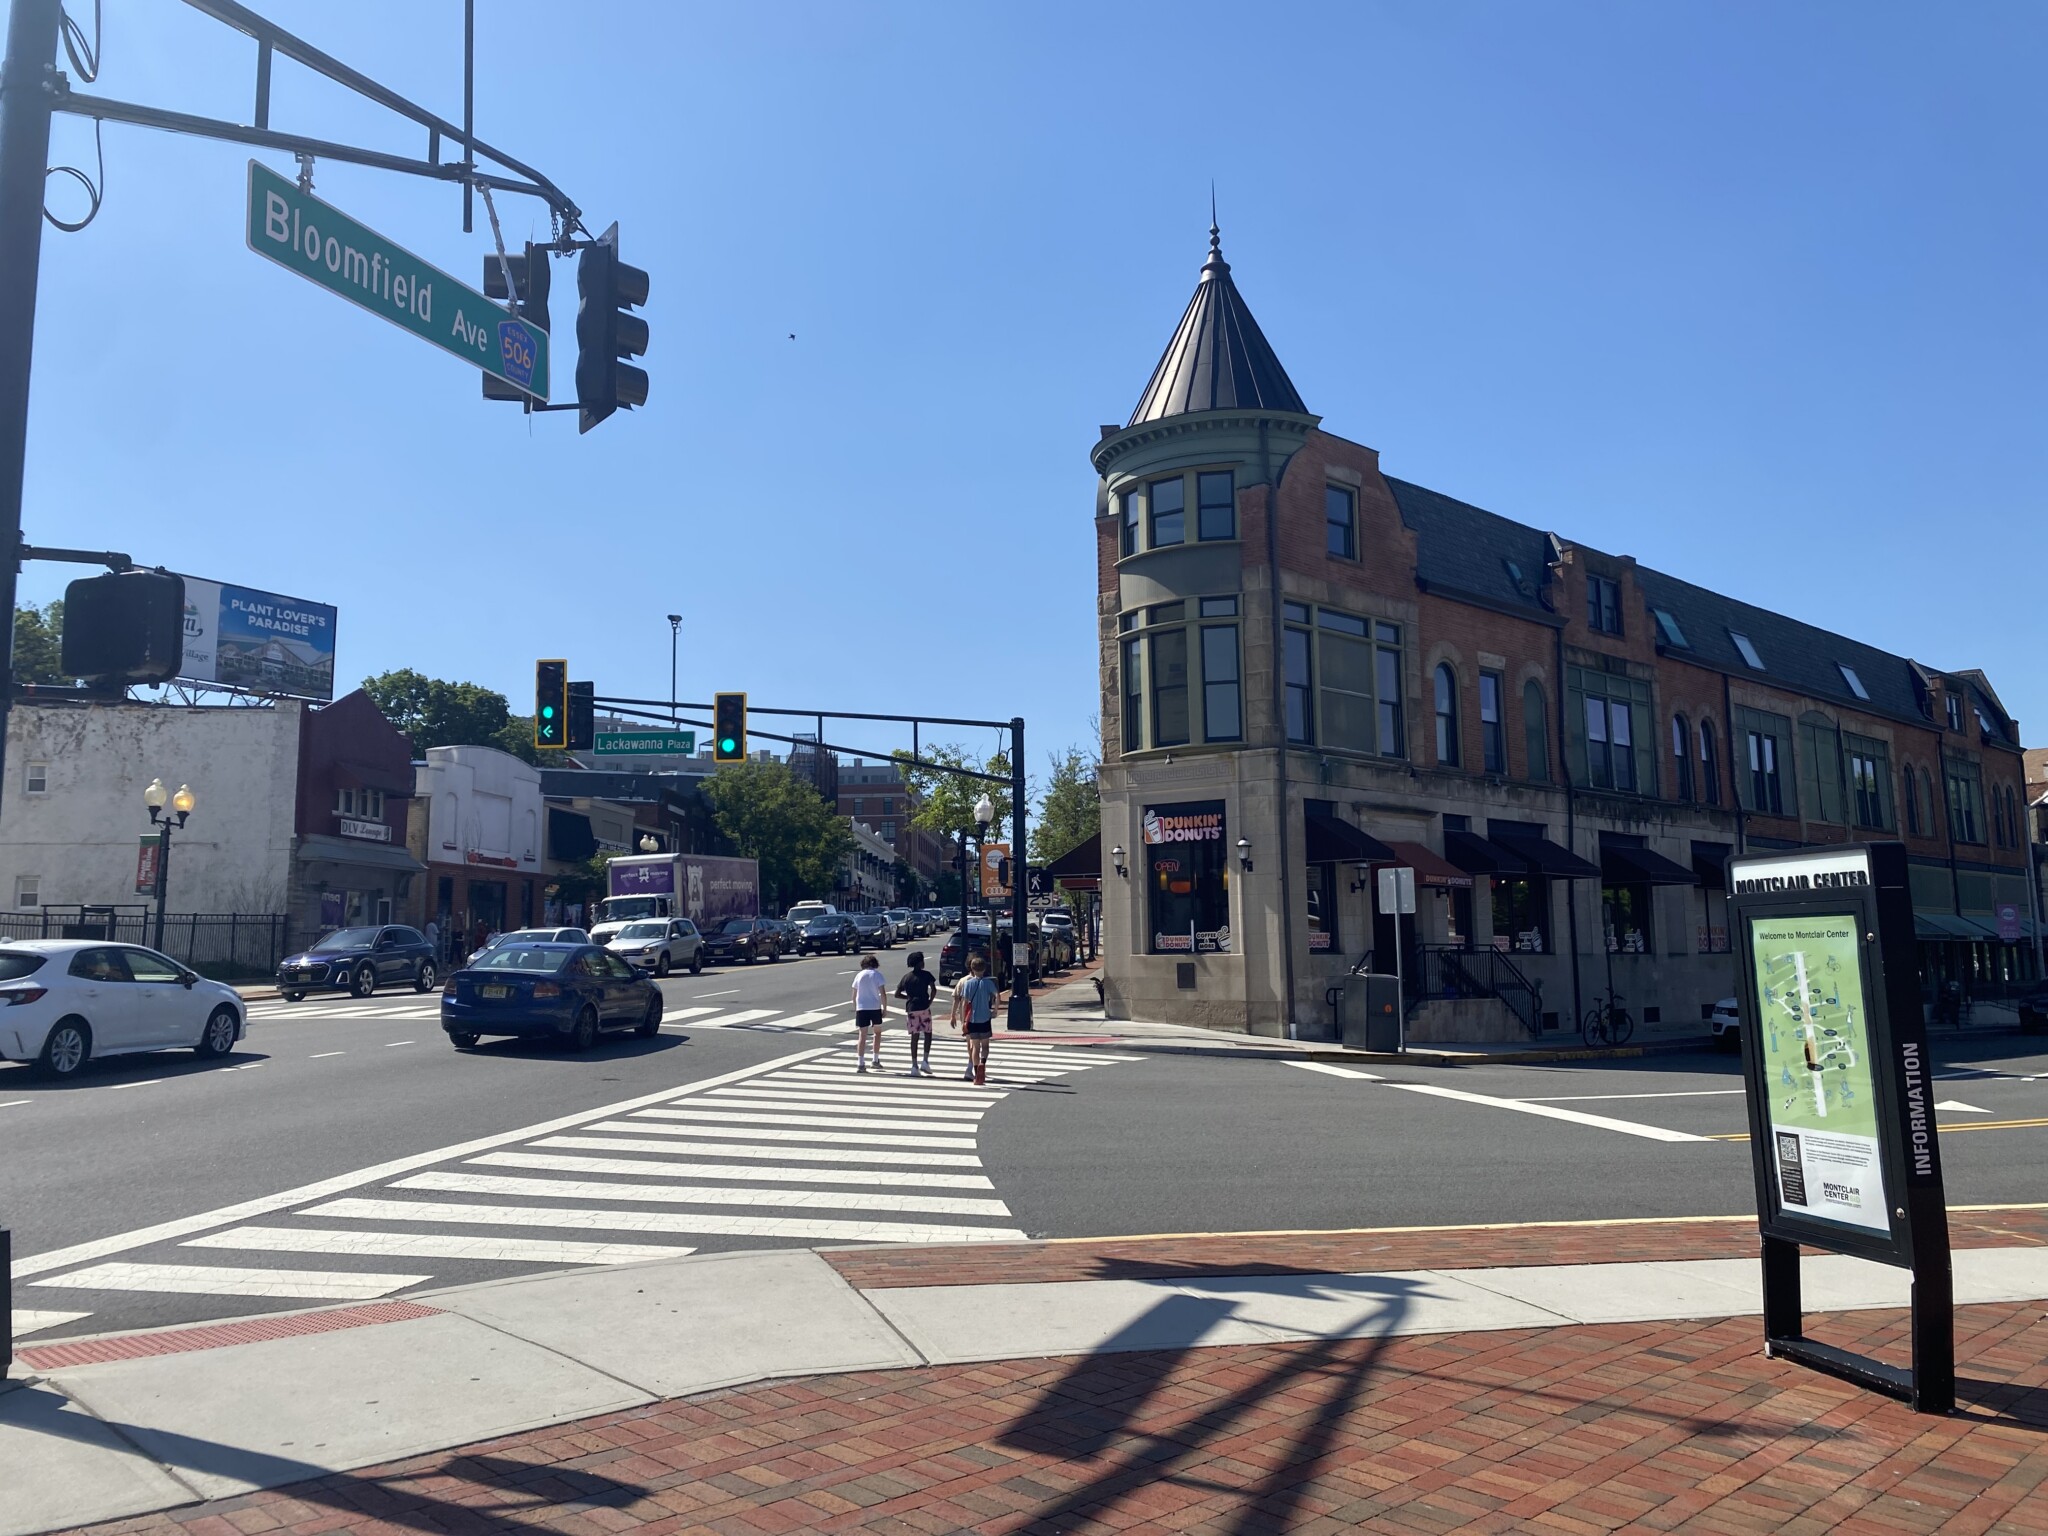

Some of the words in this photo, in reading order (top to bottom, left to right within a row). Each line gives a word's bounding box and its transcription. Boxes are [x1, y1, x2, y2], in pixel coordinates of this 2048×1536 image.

[265, 189, 432, 323] Bloomfield
[452, 309, 487, 351] Ave
[504, 336, 531, 369] 506
[231, 599, 274, 617] PLANT
[276, 608, 326, 627] LOVER'S
[248, 615, 310, 636] PARADISE
[597, 738, 663, 750] Lackawanna
[667, 739, 690, 749] Plaza
[1164, 813, 1222, 829] DUNKIN'
[1164, 827, 1220, 842] DONUTS
[1154, 861, 1179, 872] OPEN
[709, 879, 732, 891] perfect
[732, 881, 753, 892] moving
[1735, 874, 1810, 894] MONTCLAIR
[1813, 870, 1868, 888] CENTER
[1029, 894, 1051, 906] 25
[1759, 931, 1787, 940] Welcome
[1787, 931, 1795, 940] to
[1795, 930, 1825, 939] Montclair
[1826, 930, 1849, 938] Center
[1902, 1042, 1932, 1176] INFORMATION
[1823, 1182, 1860, 1196] MONTCLAIR
[1824, 1190, 1849, 1201] CENTER
